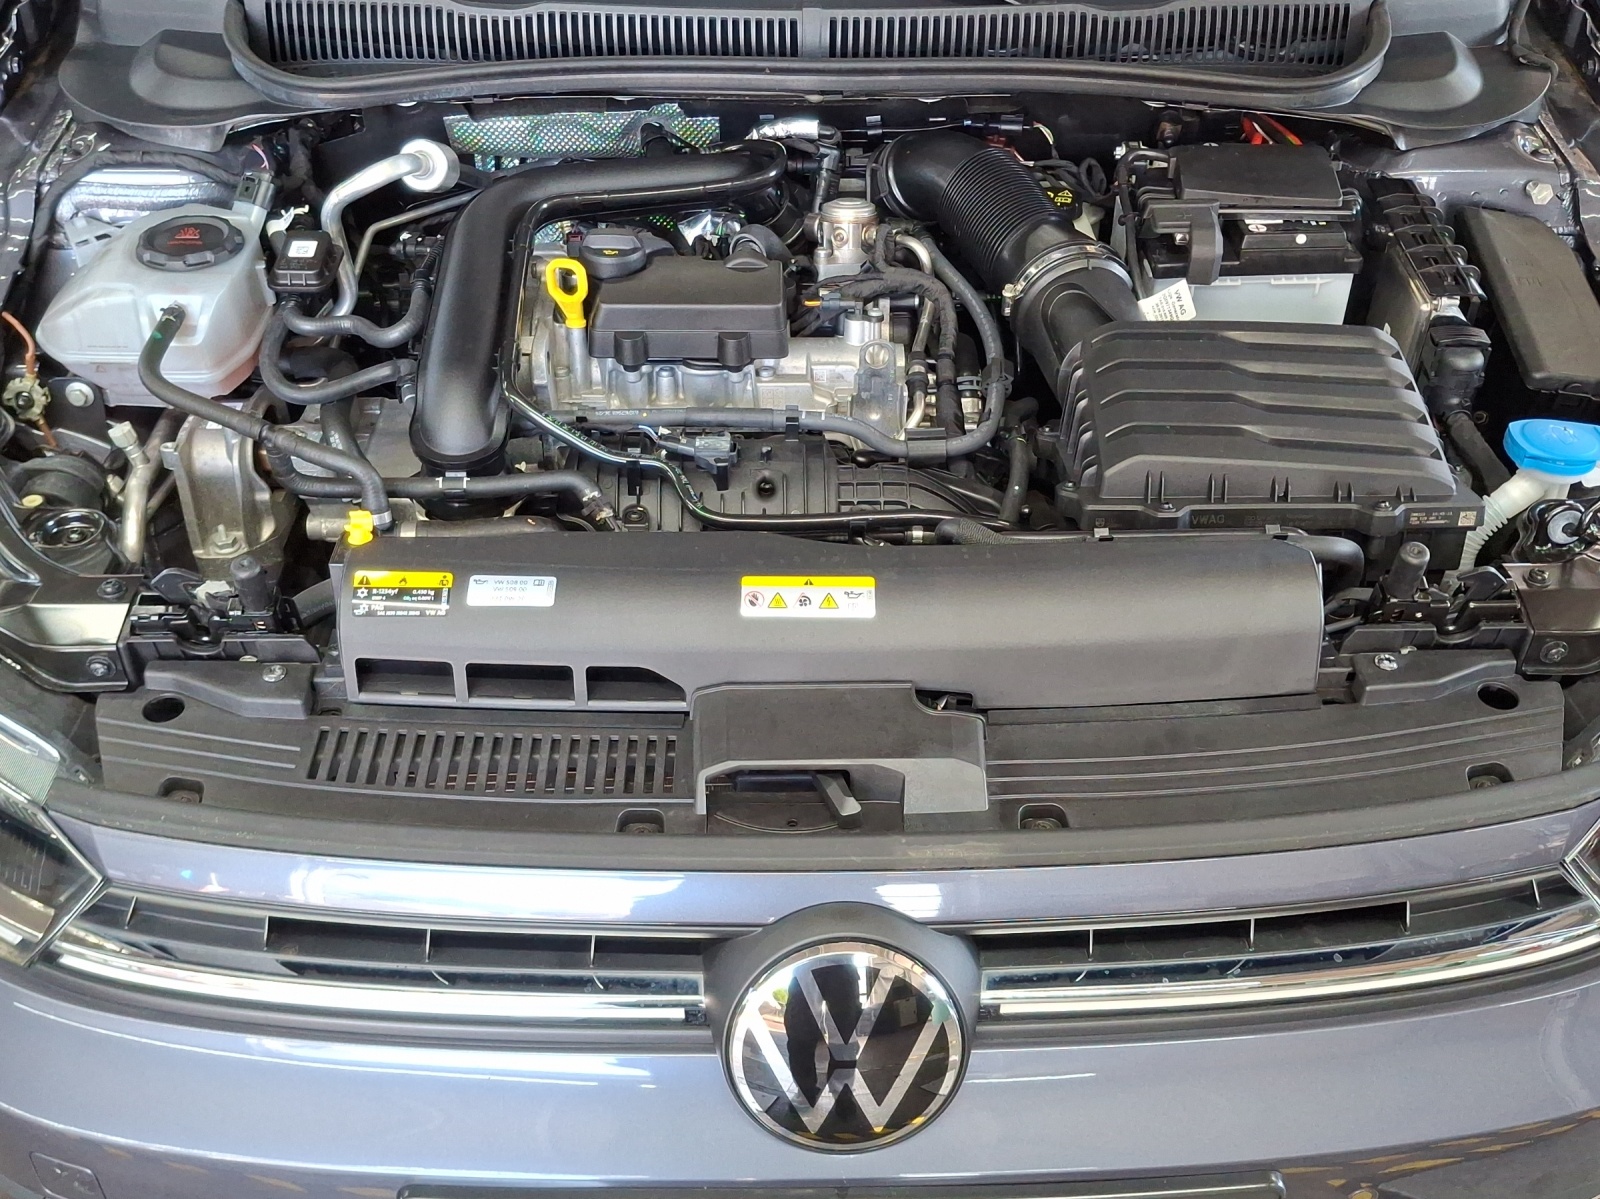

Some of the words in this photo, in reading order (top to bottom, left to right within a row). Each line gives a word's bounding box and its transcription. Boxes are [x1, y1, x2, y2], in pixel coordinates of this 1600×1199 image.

[1174, 289, 1183, 302] VW
[1178, 304, 1187, 316] AG
[1191, 514, 1225, 525] VWAG
[736, 948, 956, 1140] VW
